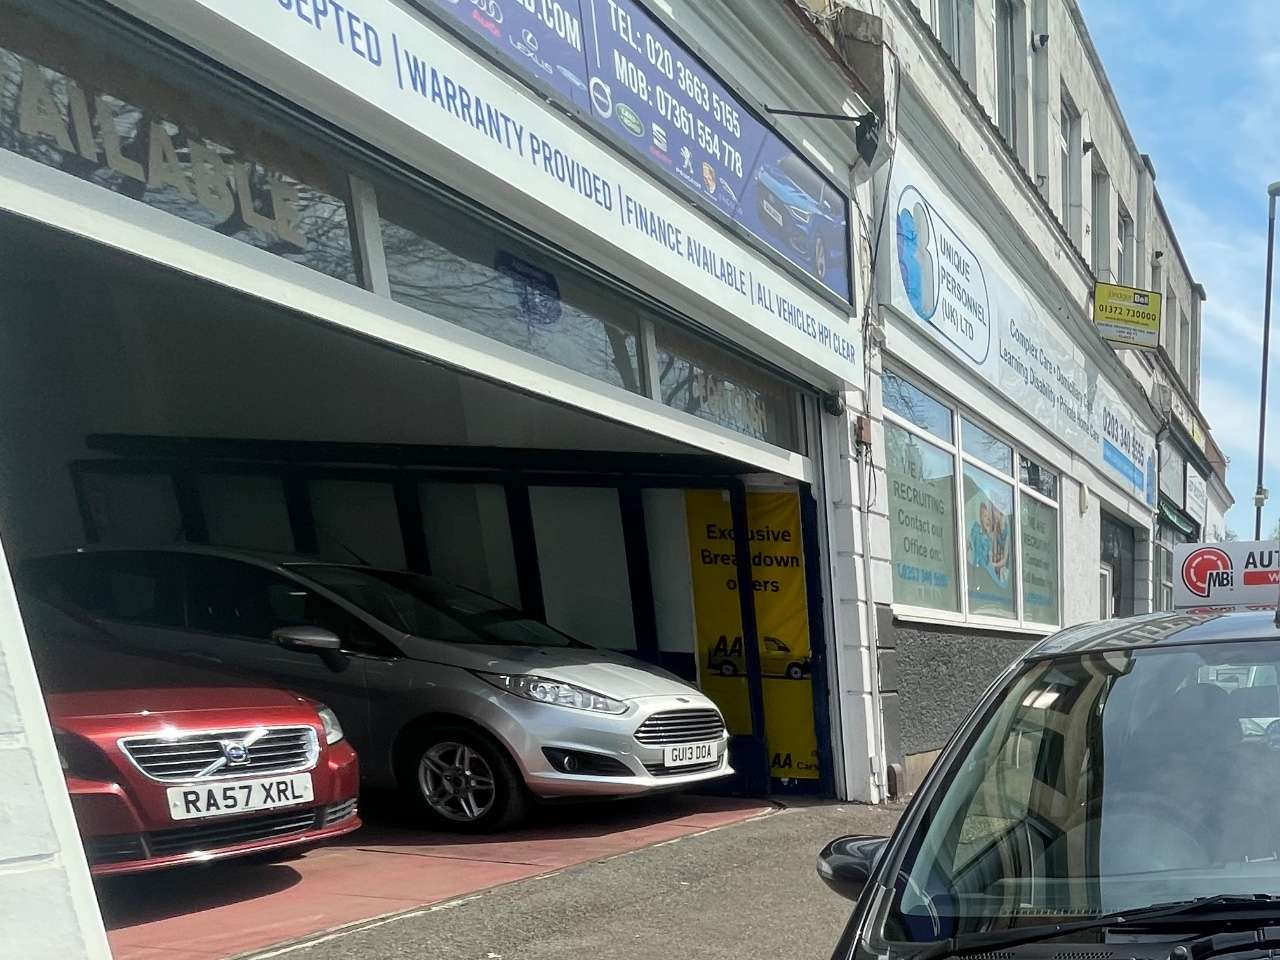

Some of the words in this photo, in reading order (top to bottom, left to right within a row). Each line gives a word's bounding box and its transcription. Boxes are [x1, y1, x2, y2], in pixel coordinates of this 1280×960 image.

[608, 0, 642, 53] TEL:
[646, 33, 674, 80] 020
[676, 61, 710, 113] 3663
[712, 92, 741, 139] 5155
[614, 49, 653, 106] MOB:
[655, 85, 695, 140] 07361
[697, 119, 720, 161] 554
[722, 140, 743, 178] 778
[404, 50, 524, 156] WARRANTY
[529, 132, 613, 211] PROVIDED
[625, 194, 684, 257] FINANCE
[687, 235, 746, 296] AVAILABLE
[757, 282, 775, 314] ALL
[776, 294, 817, 341] VEHICLES
[818, 321, 832, 349] HPI
[833, 332, 856, 365] CLEAR
[939, 233, 971, 283] UNIQUE
[940, 265, 987, 327] PERSONNEL
[1098, 303, 1123, 316] 01372
[1125, 308, 1157, 321] 730000
[941, 295, 959, 333] (UK)
[960, 315, 975, 341] LTD
[1009, 318, 1038, 361] Complex
[1039, 348, 1053, 375] Care
[1000, 338, 1029, 385] Learning
[1029, 367, 1056, 408] Disability
[1102, 406, 1119, 442] 0203
[893, 480, 945, 515] RECRUITING
[706, 523, 792, 542] Excusive
[897, 508, 930, 536] Contact
[701, 549, 800, 568] Breadown
[903, 536, 928, 557] Office
[727, 577, 780, 592] oers
[713, 635, 743, 656] AA
[671, 746, 694, 762] GU13
[771, 752, 792, 769] AA
[183, 785, 252, 814] RA57
[260, 780, 304, 805] XRL
